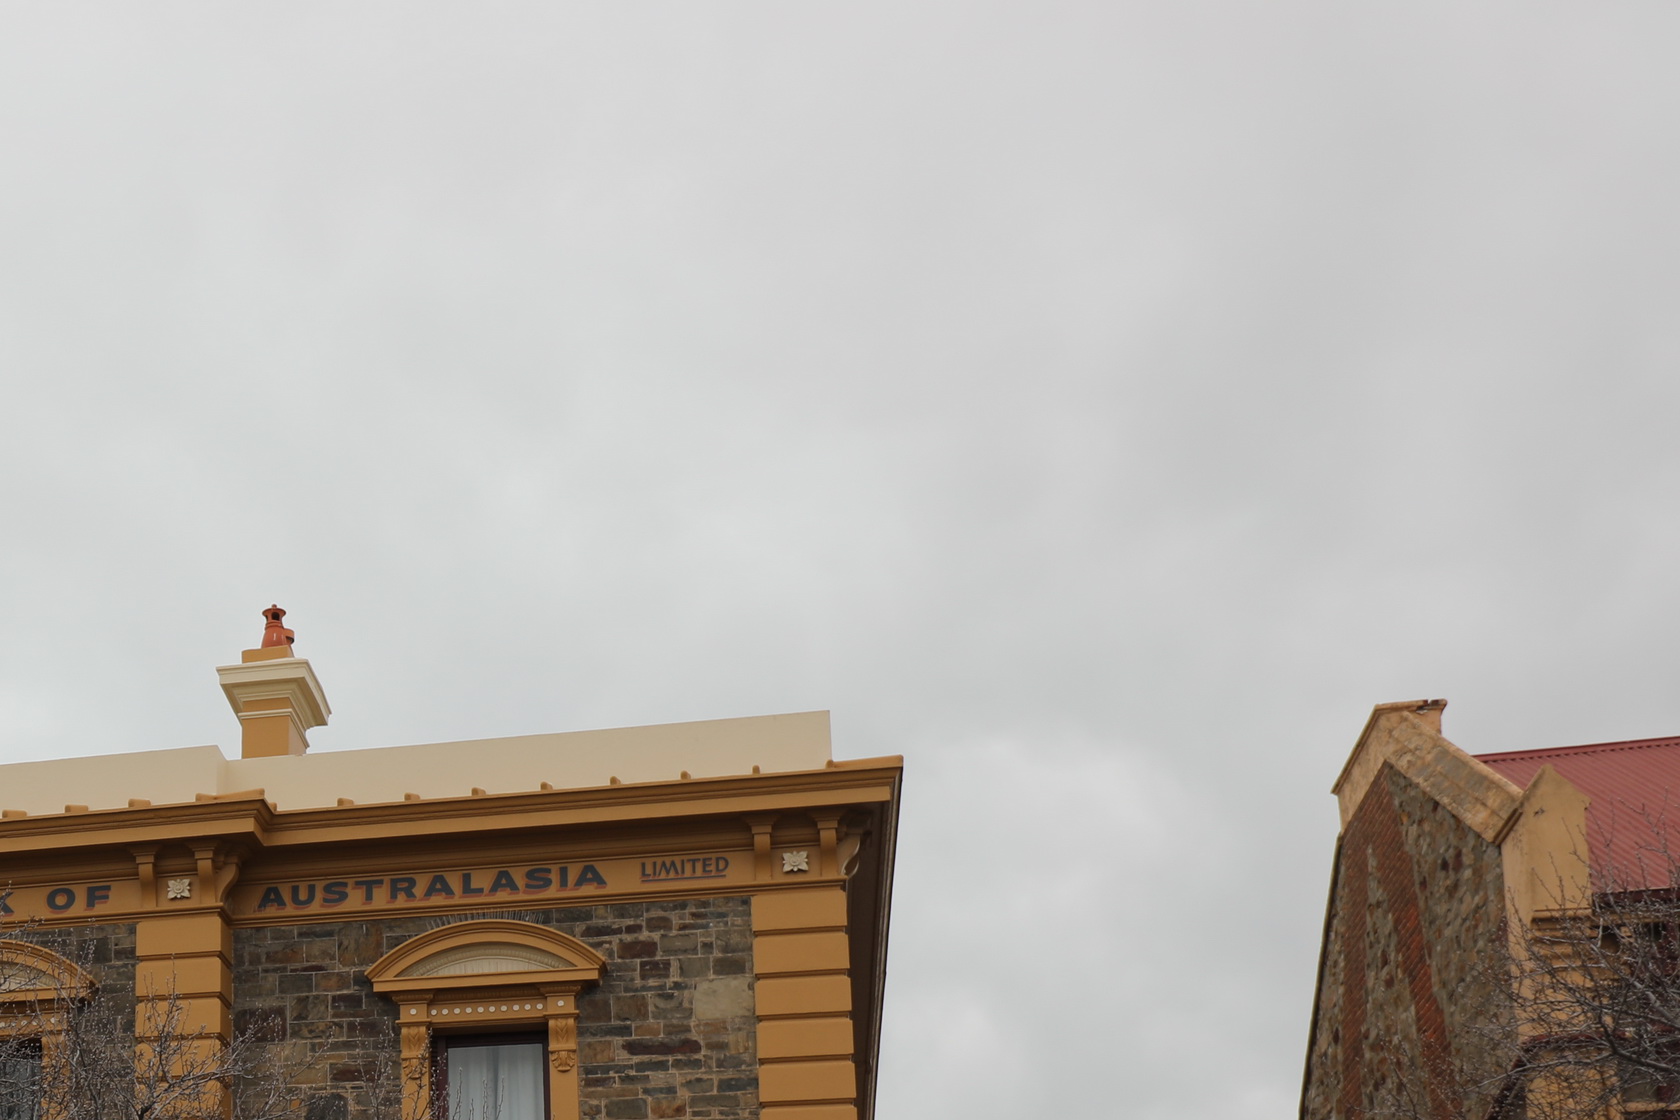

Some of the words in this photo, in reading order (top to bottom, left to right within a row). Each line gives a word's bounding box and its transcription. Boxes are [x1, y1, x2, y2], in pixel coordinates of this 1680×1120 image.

[640, 857, 729, 881] LIMITED
[44, 884, 111, 914] OF
[254, 864, 607, 911] AUSTRALASIA
